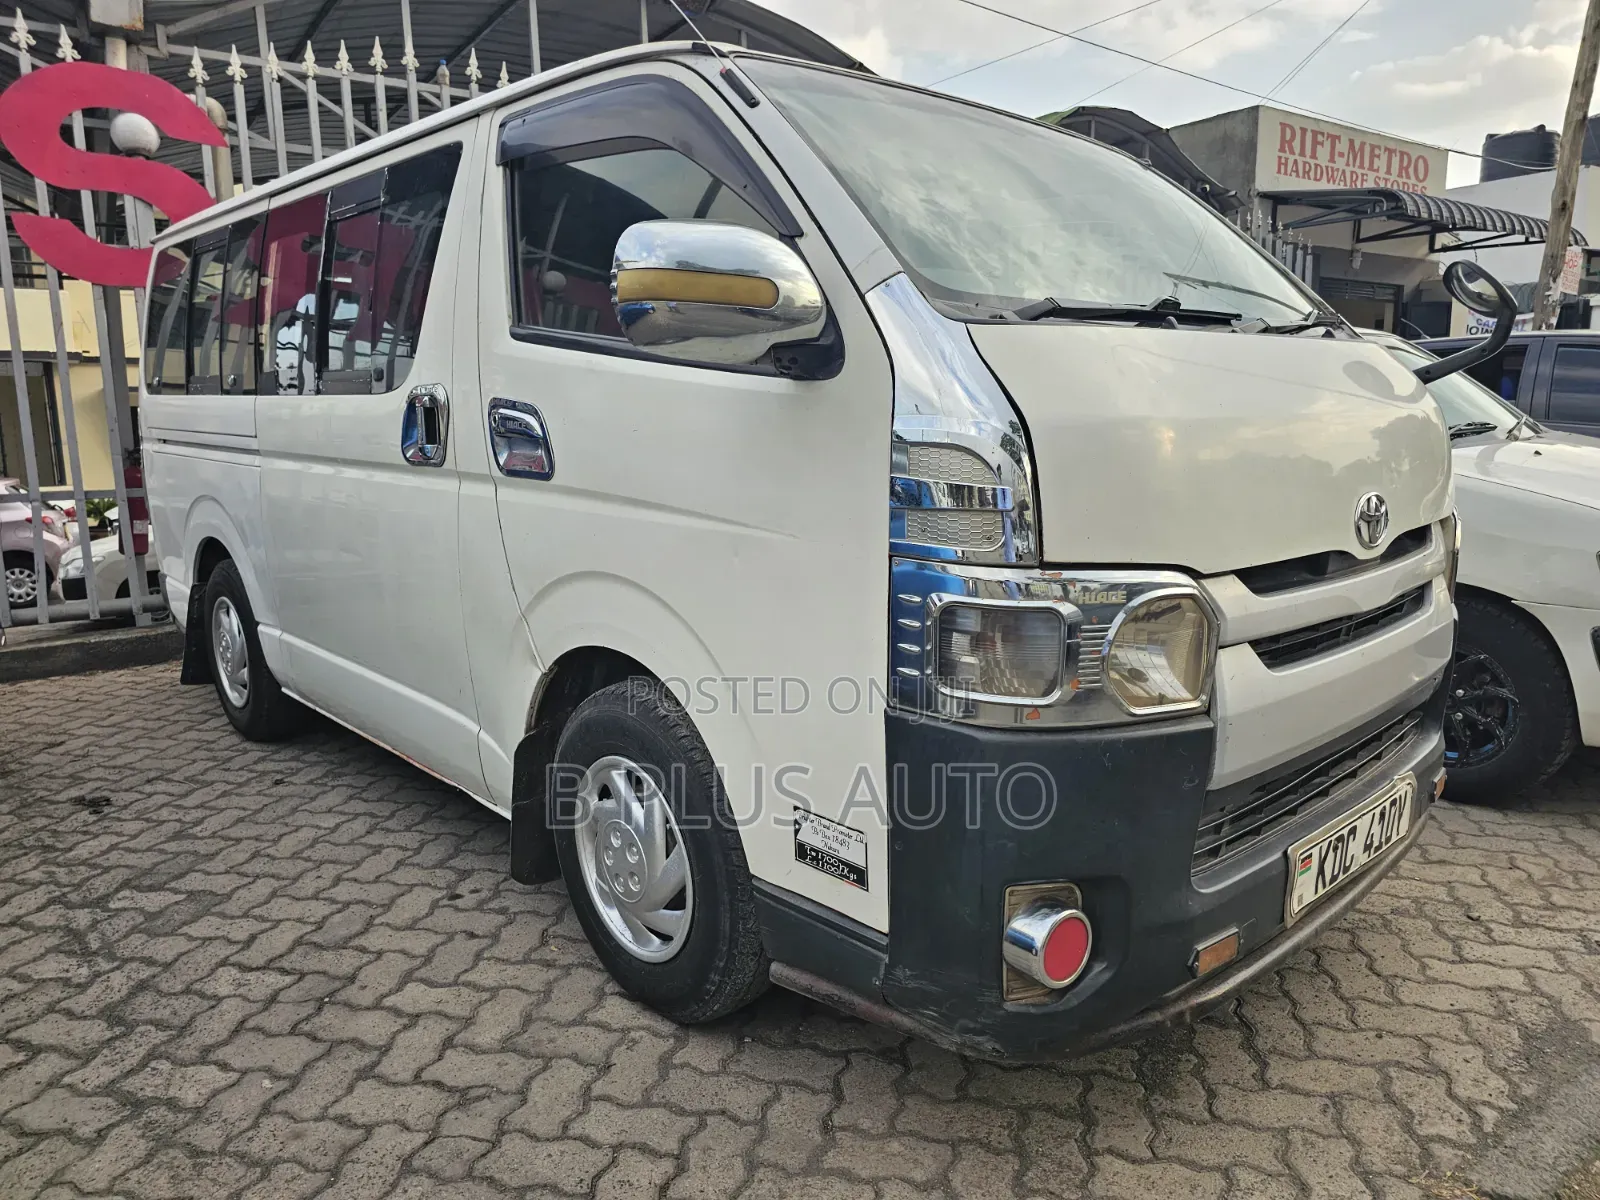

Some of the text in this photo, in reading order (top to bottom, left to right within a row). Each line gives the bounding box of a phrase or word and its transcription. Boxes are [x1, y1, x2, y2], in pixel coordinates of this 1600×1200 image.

[1276, 155, 1369, 189] HARDWARE
[1277, 121, 1429, 183] RIFT-METRO
[1078, 591, 1127, 604] HIACE
[1314, 790, 1408, 895] KDC 410Y
